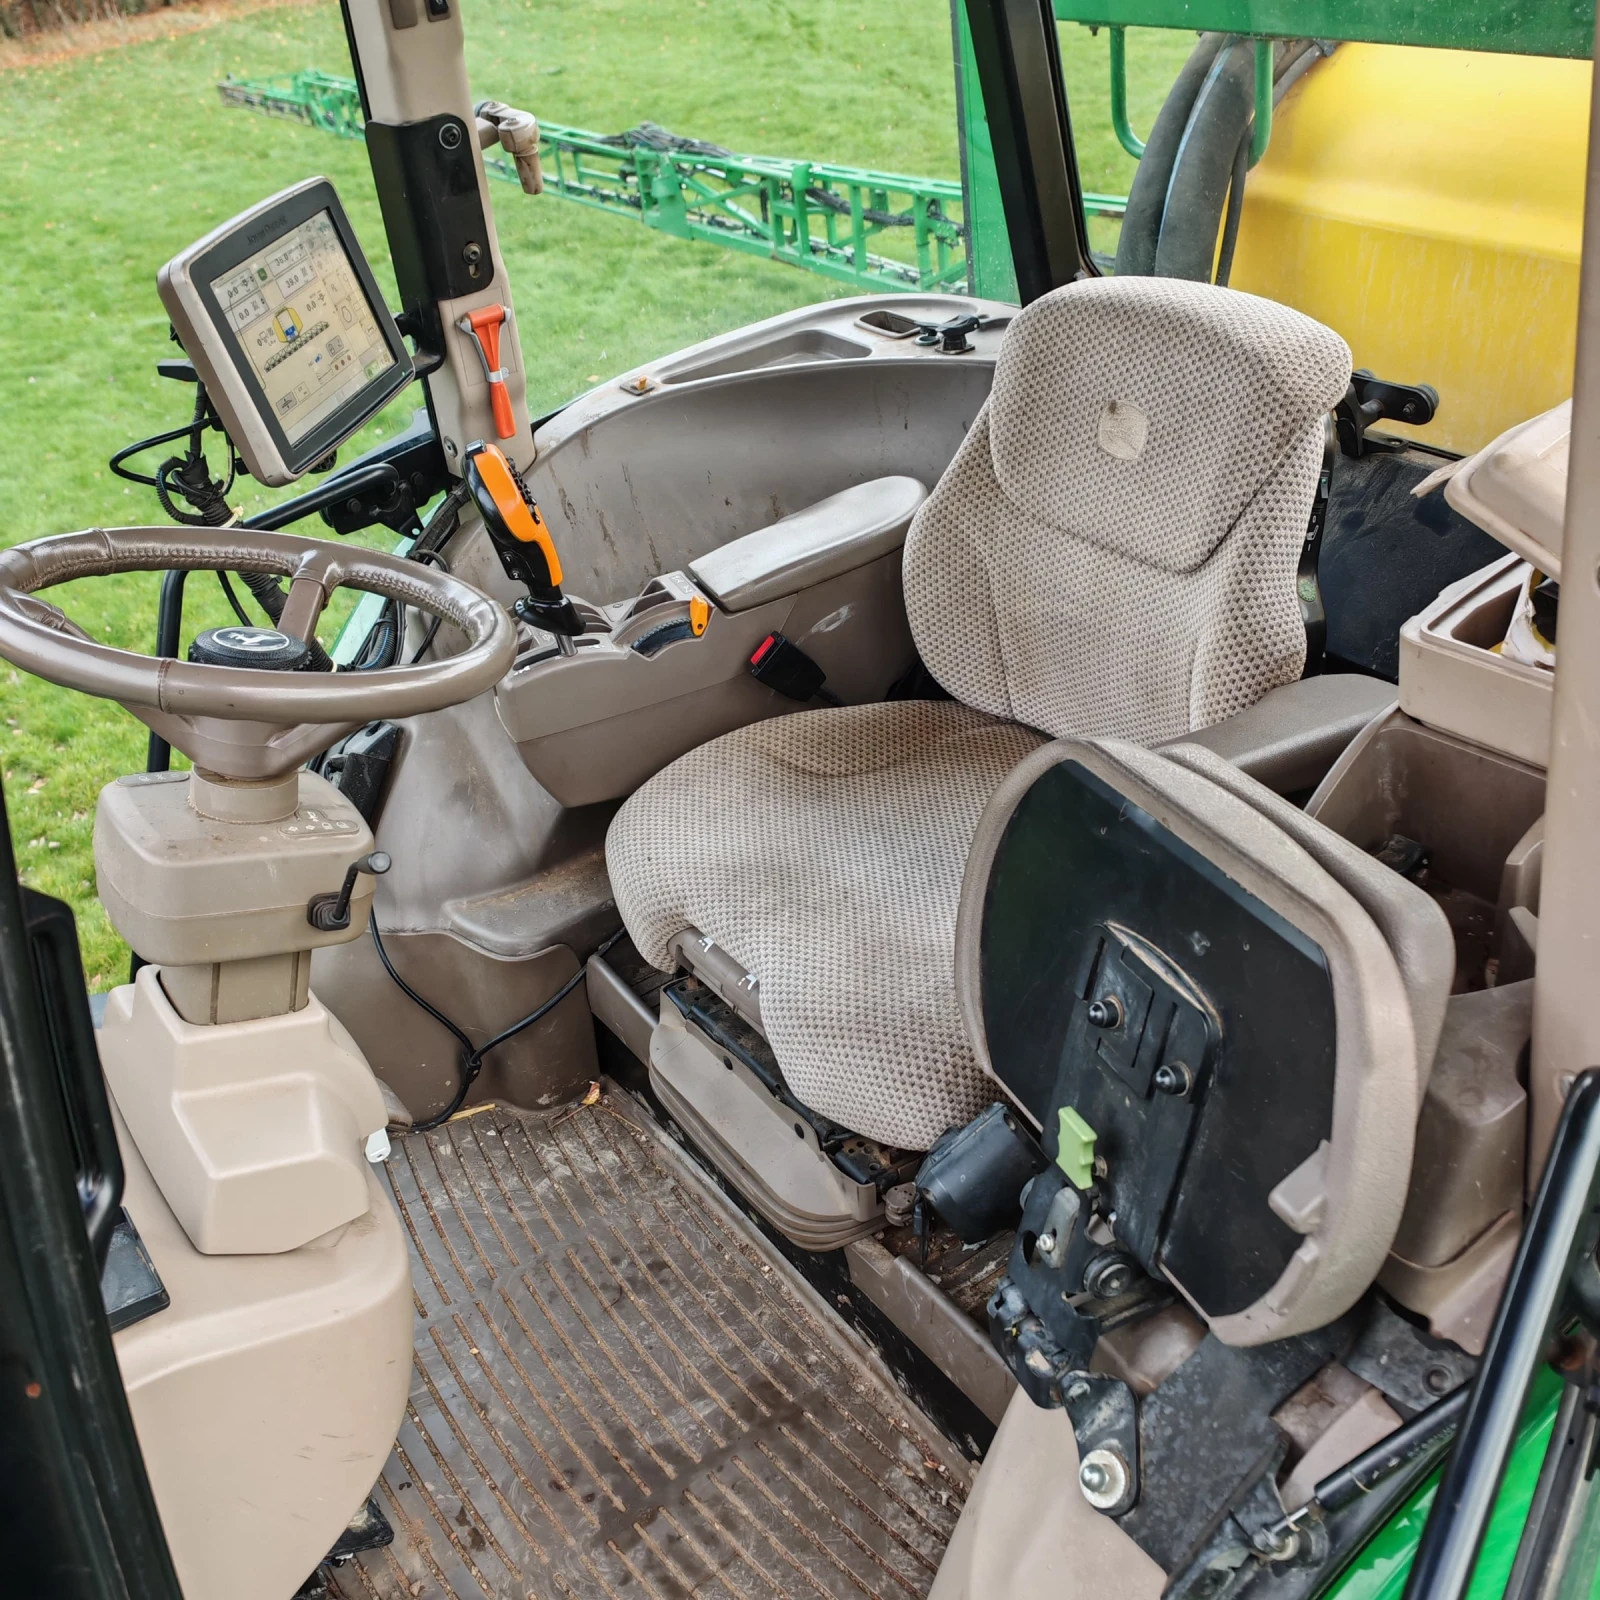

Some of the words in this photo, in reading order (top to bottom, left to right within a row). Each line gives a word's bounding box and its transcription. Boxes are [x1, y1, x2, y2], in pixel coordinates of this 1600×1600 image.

[284, 274, 300, 290] 39.0
[227, 286, 239, 299] 0.0
[306, 300, 317, 312] 0.0
[238, 308, 250, 321] 0.0
